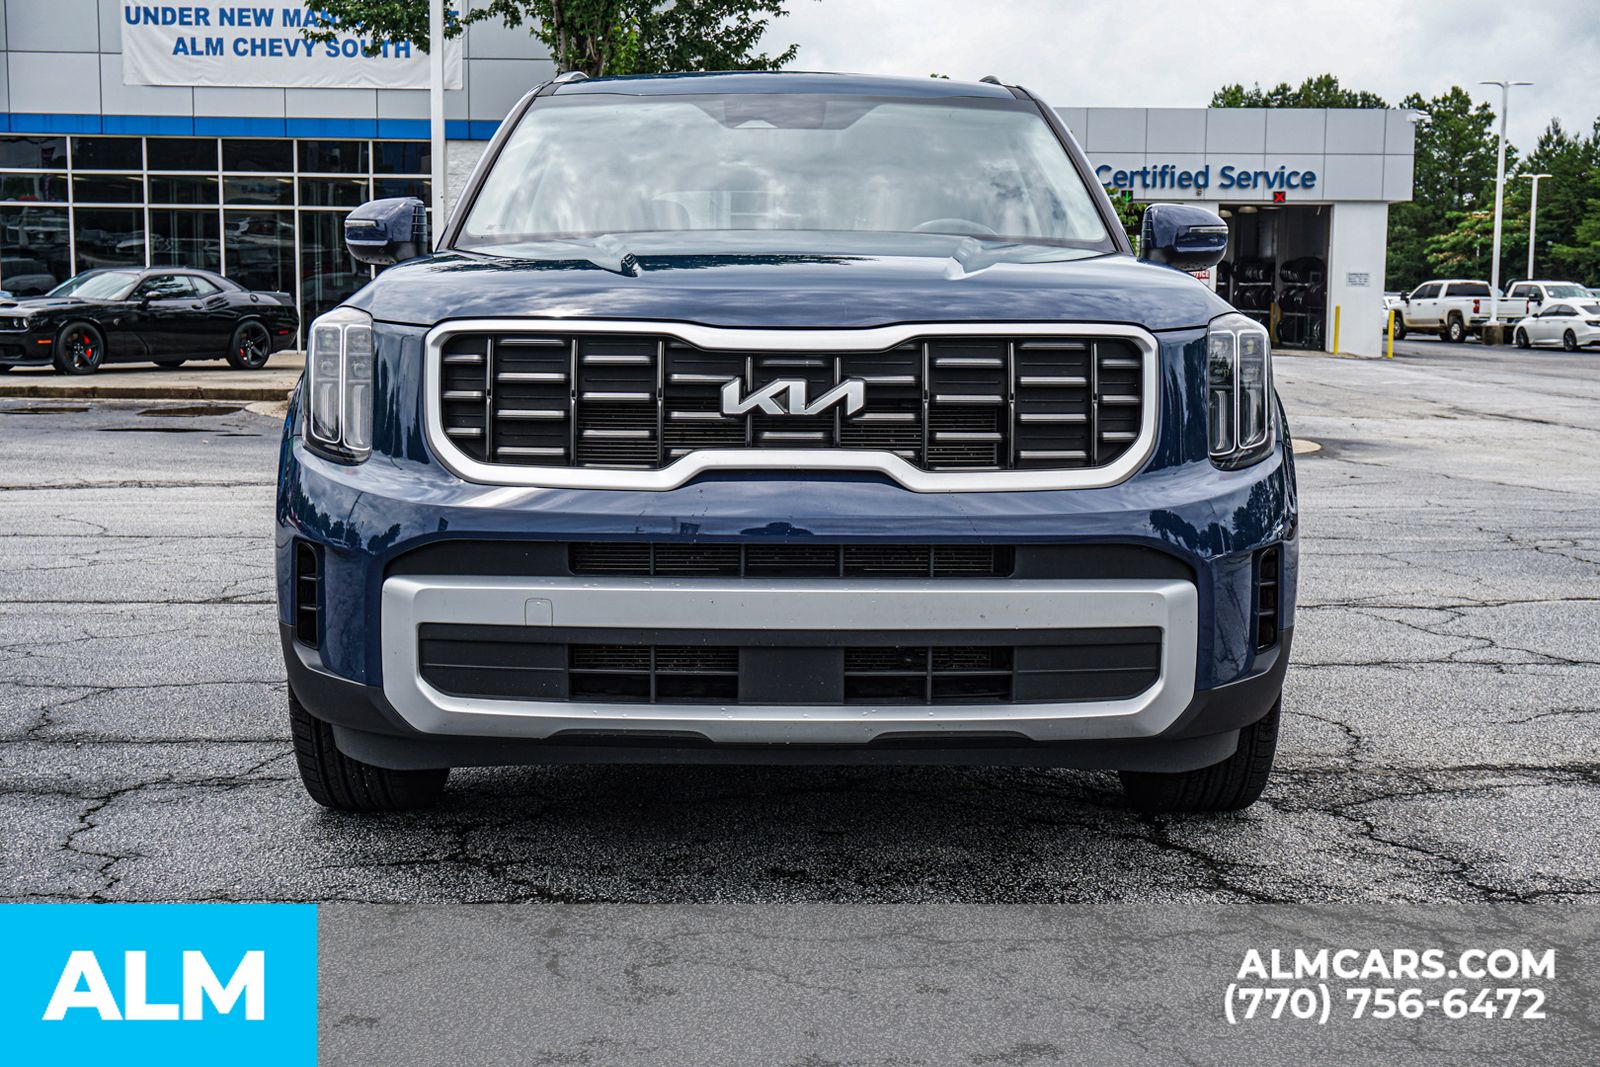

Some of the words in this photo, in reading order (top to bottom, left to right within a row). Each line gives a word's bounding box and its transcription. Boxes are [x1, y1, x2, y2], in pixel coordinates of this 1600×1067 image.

[125, 6, 211, 27] UNDER
[218, 8, 274, 28] NEW
[172, 37, 224, 56] ALM
[232, 37, 316, 58] CHEVY
[326, 38, 411, 59] SOUTH
[1095, 164, 1210, 189] Certified
[1218, 165, 1317, 189] Service
[721, 376, 866, 416] KIA
